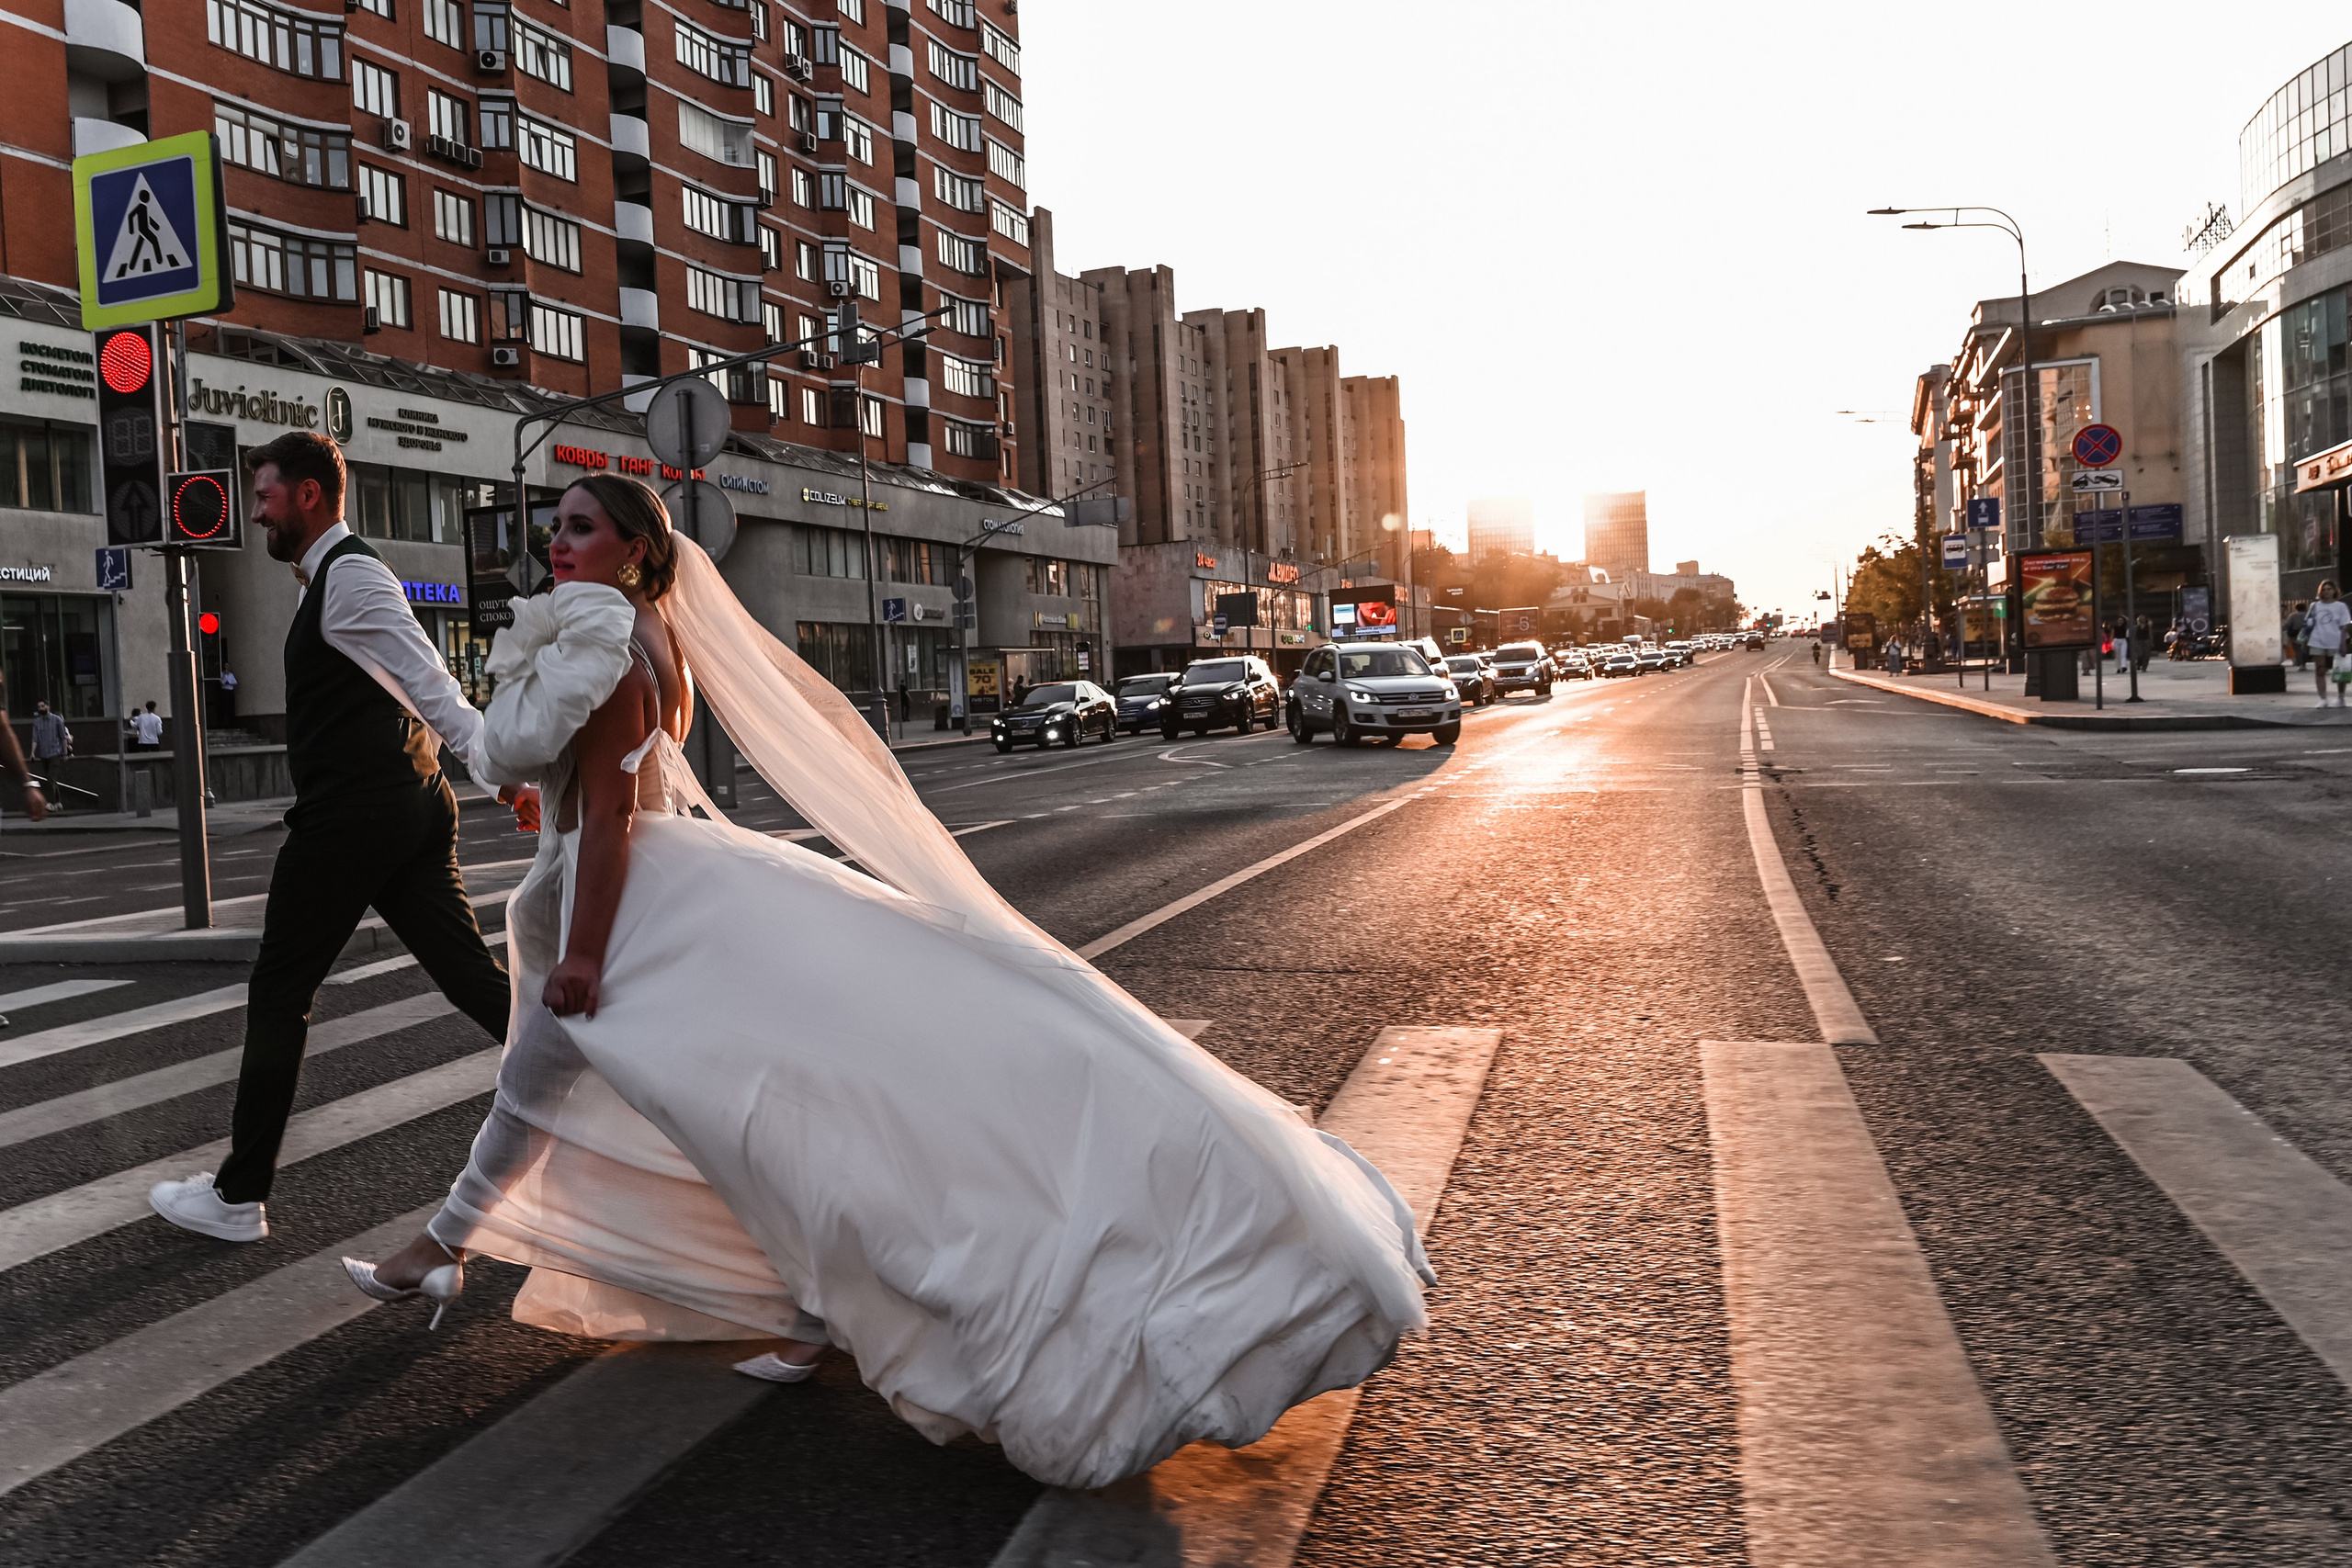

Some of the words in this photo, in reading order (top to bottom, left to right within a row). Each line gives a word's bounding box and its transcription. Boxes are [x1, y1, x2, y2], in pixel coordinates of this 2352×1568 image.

[19, 341, 93, 365] КОСМЕТОЛ
[20, 360, 95, 382] СТОМАТОЛ
[188, 378, 319, 428] Juviclinic
[398, 408, 439, 423] КЛИНИКА
[368, 417, 415, 434] МУЖСКОГО
[416, 425, 424, 434] И
[424, 426, 468, 442] ЖЕНСКОГО
[398, 436, 442, 451] ЗДОРОВЬЯ
[555, 445, 608, 470] КОВРЫ
[618, 456, 655, 476] ГАНГ
[661, 463, 706, 480] КОЫ
[809, 490, 846, 505] COLIZEUM
[0, 566, 51, 582] СТИЦИЙ
[401, 581, 461, 604] ПТЕКА
[479, 599, 508, 611] ОЩУТ
